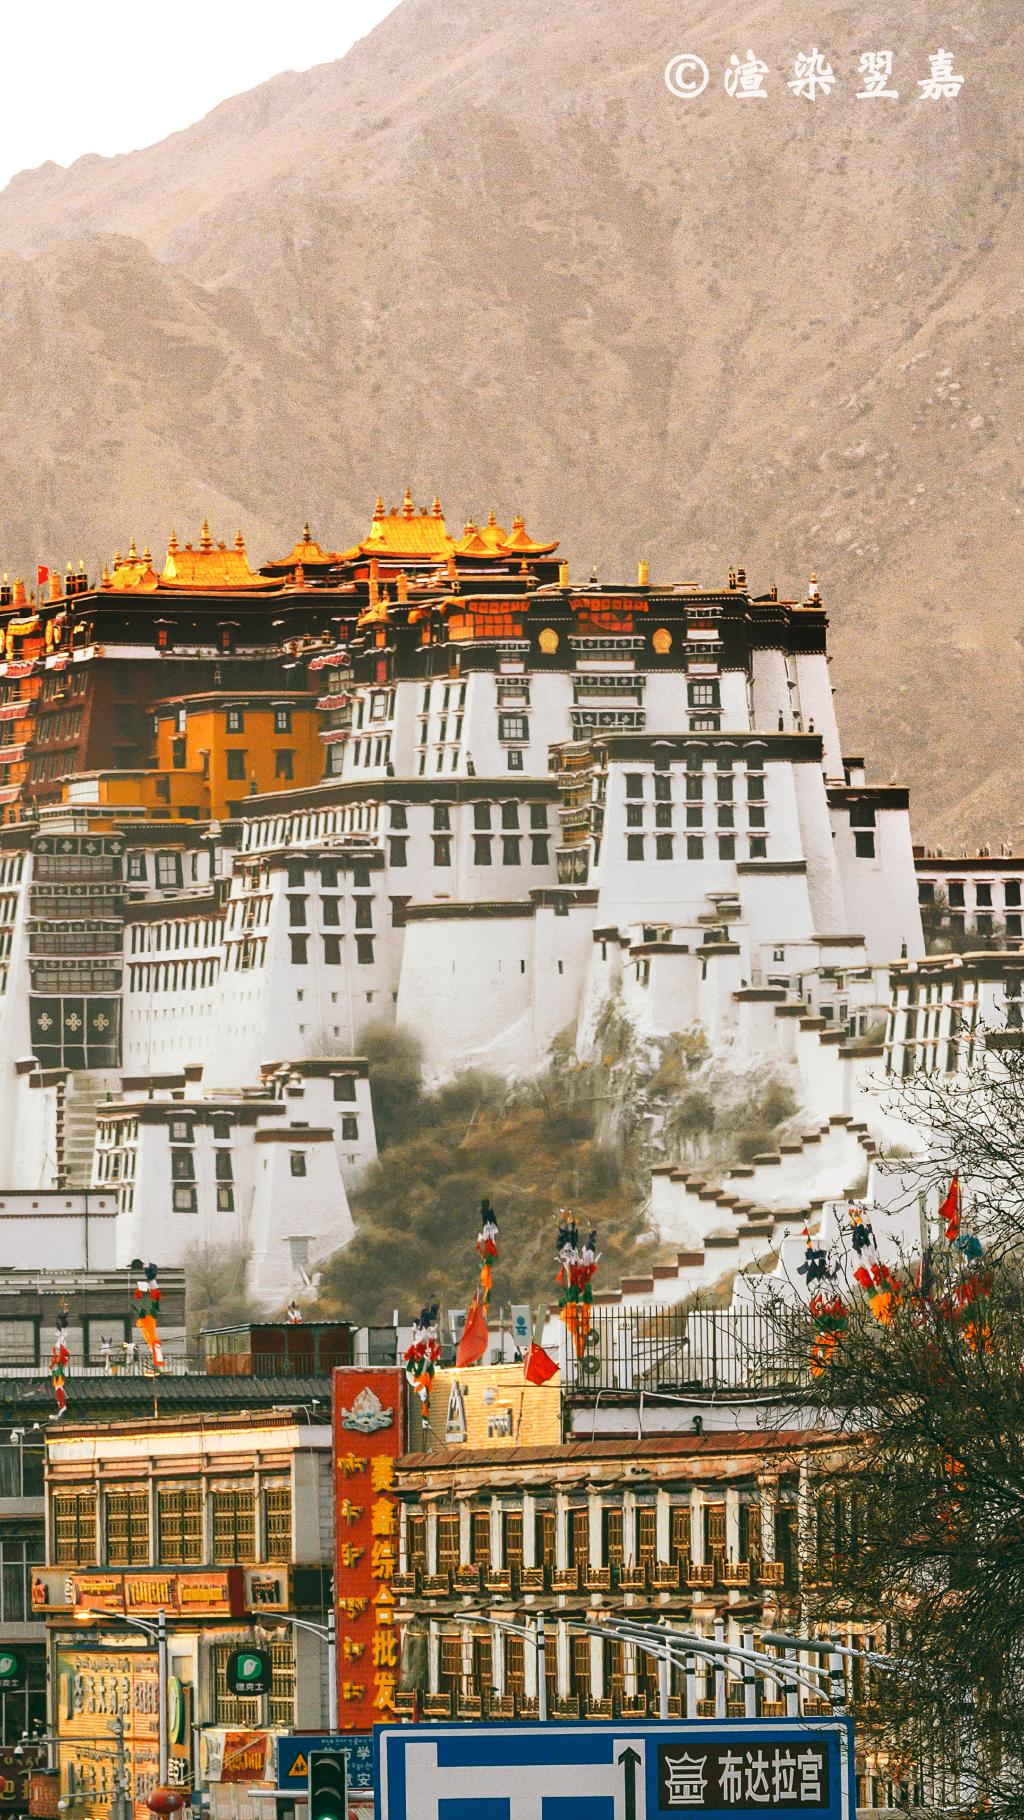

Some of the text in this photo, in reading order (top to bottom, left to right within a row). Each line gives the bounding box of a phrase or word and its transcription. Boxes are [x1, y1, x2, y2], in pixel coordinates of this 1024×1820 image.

[370, 1454, 397, 1724] 赛鑫综合批发
[718, 1749, 823, 1804] 布达拉宫
